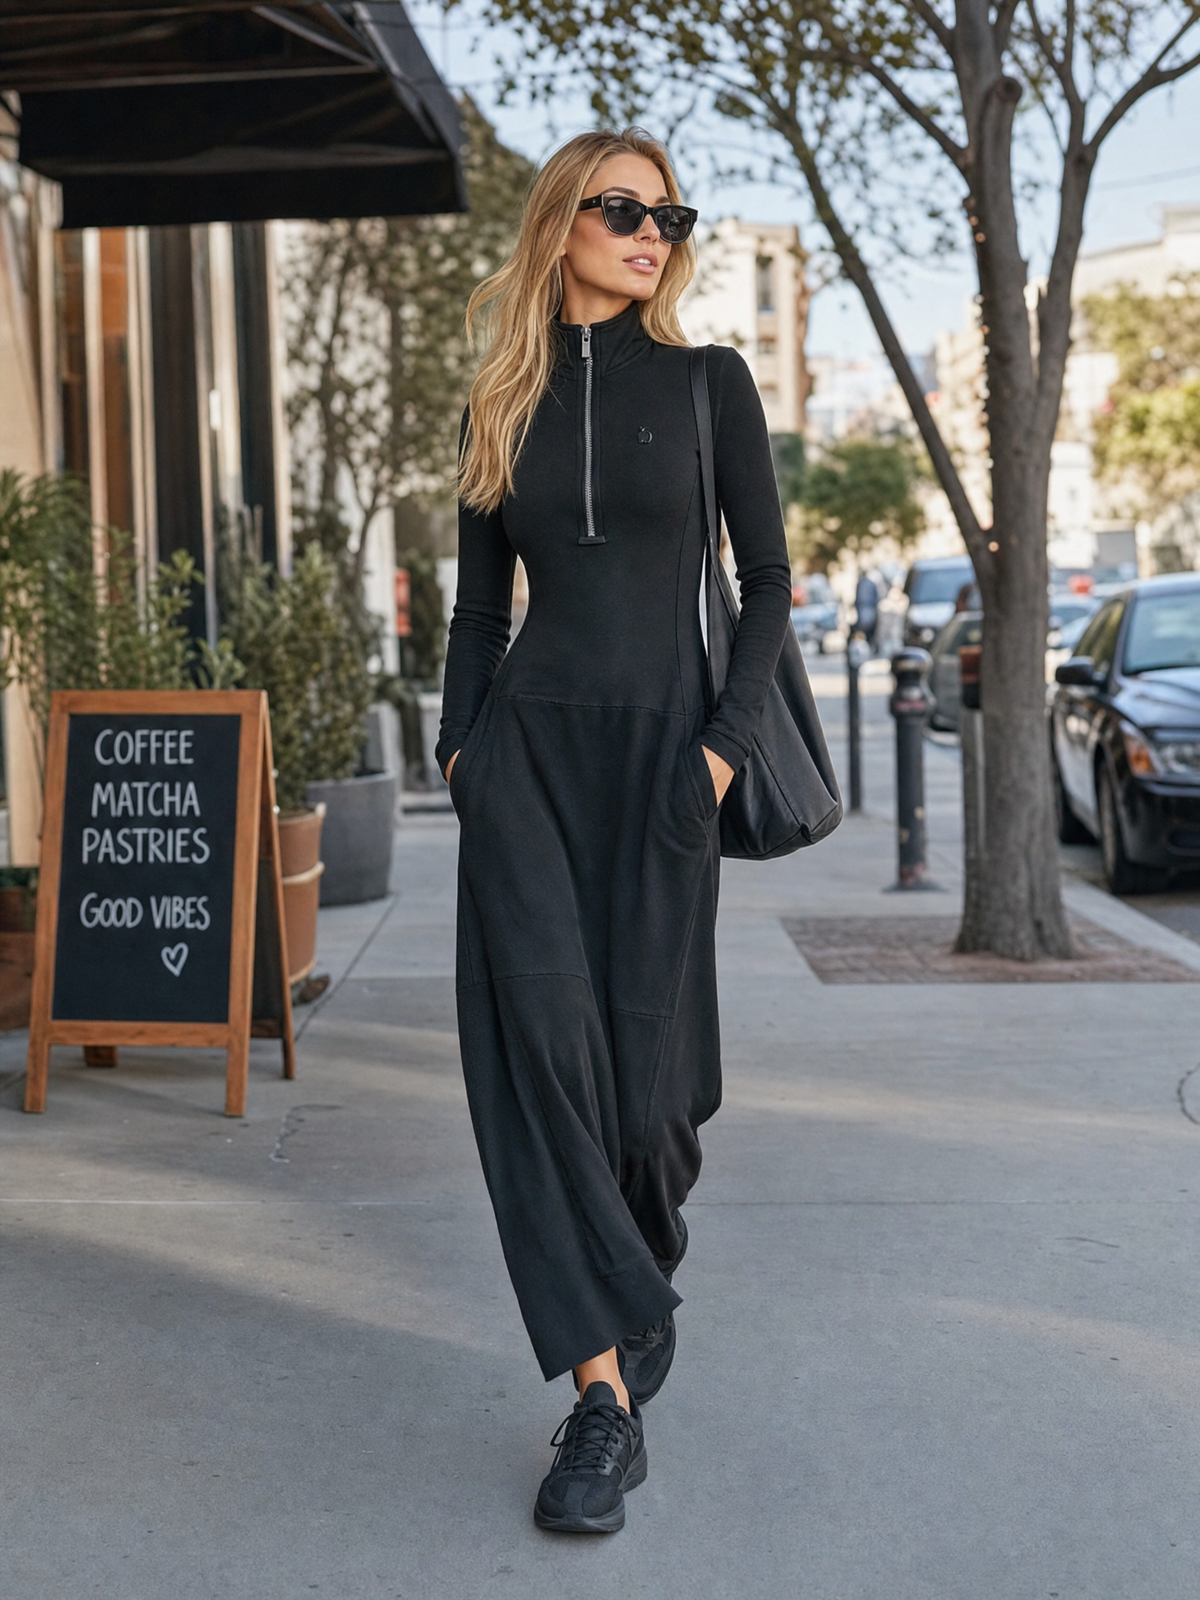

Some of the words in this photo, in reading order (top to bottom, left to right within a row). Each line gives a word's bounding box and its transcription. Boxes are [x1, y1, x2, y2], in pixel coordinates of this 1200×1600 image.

[95, 729, 194, 765] COFFEE
[92, 782, 200, 817] MATCHA
[83, 828, 210, 864] PASTRIES
[80, 893, 143, 928] GOOD
[150, 896, 210, 930] VIBES
